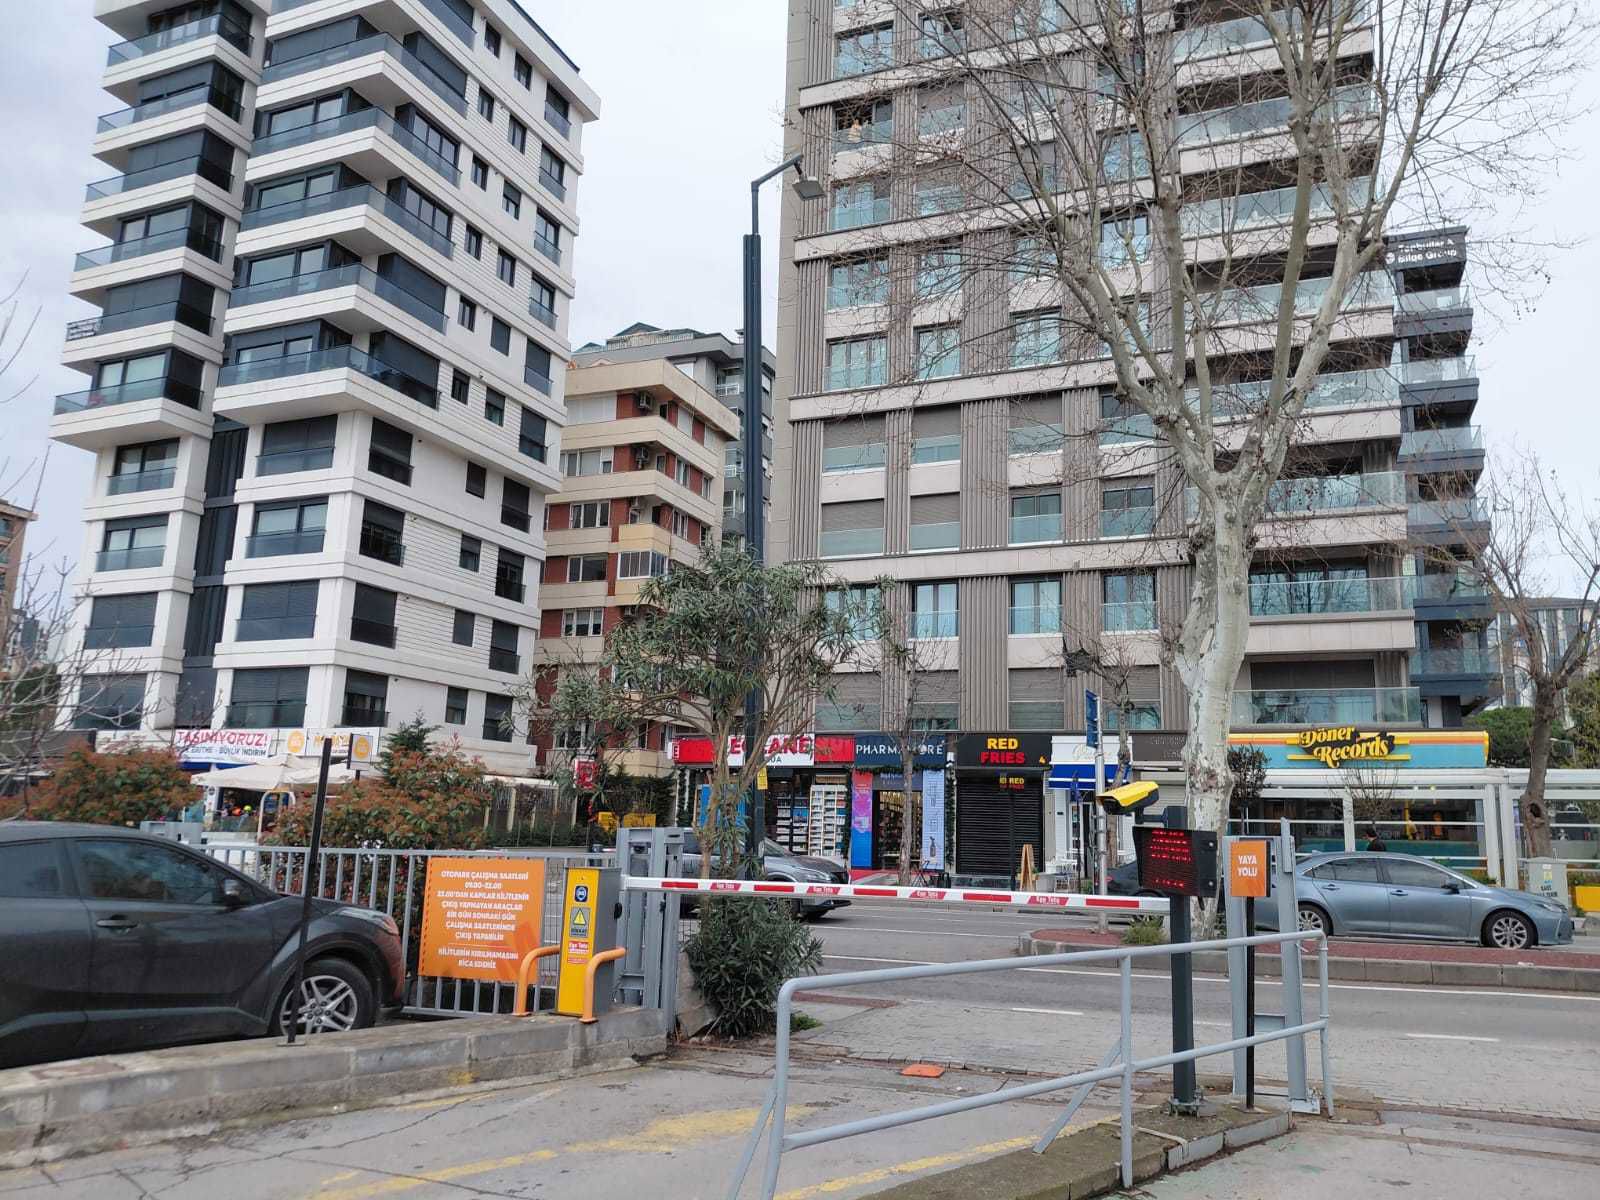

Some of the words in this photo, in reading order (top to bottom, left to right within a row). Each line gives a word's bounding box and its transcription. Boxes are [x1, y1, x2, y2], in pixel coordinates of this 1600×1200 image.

[1301, 726, 1356, 748] Döner
[730, 735, 813, 755] EANE
[987, 738, 1018, 750] RED
[980, 751, 1025, 764] FRIES
[1313, 736, 1390, 769] Records
[1238, 855, 1257, 865] YAYA
[1237, 867, 1258, 877] YOLU
